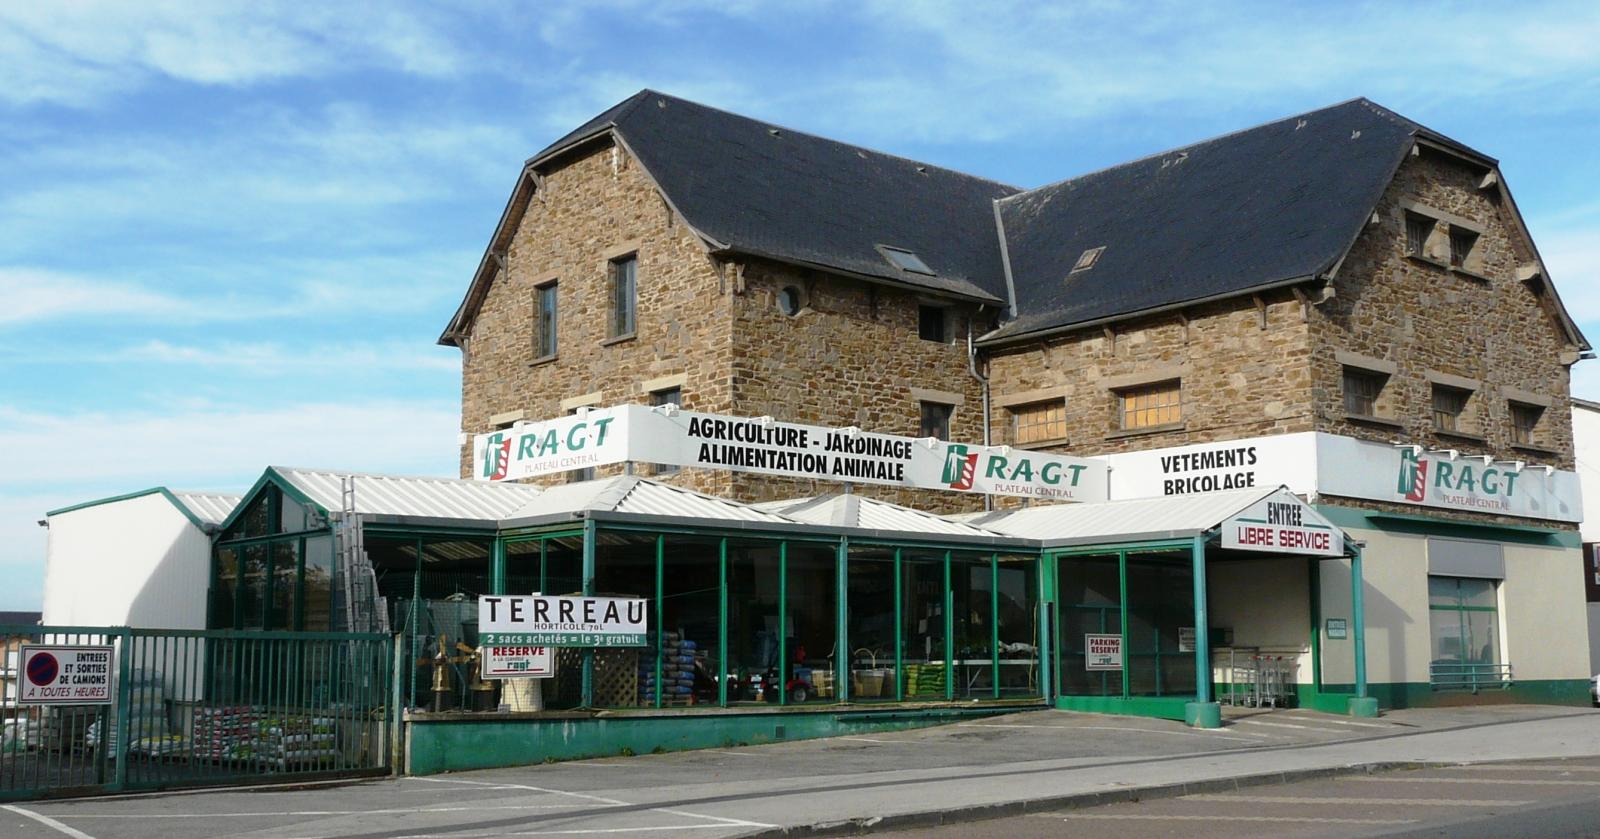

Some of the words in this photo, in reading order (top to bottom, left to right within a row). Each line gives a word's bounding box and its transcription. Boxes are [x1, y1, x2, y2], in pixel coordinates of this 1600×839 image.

[687, 416, 808, 448] AGRICULTURE
[825, 432, 913, 460] JARDINAGE
[524, 459, 559, 473] PLATEAU
[560, 452, 599, 467] CENTRAL
[698, 443, 828, 473] ALIMENTATION
[832, 456, 904, 482] ANIMALE
[1161, 446, 1257, 473] VETEMENTS
[994, 484, 1033, 496] PLATEAU
[1035, 486, 1074, 499] CENTRAL
[1163, 472, 1255, 496] BRICOLAGE
[1443, 494, 1475, 506] PLATEAU
[1476, 498, 1509, 511] CENTRAL
[1267, 501, 1302, 527] ENTREE
[1238, 527, 1274, 546] LIBRE
[1279, 530, 1330, 550] SERVICE
[485, 597, 644, 625] TERREAU
[534, 622, 586, 631] HORTICOLE
[487, 634, 494, 643] 2
[499, 635, 522, 643] sacs
[526, 633, 566, 643] achetés
[581, 634, 591, 643] le
[606, 634, 640, 646] gratuit
[1090, 638, 1120, 646] PARKING
[77, 652, 108, 662] ENTREES
[492, 646, 545, 657] RESERVE
[65, 663, 73, 673] ET
[77, 663, 107, 674] SORTIES
[60, 675, 69, 684] DE
[72, 674, 106, 684] CAMIONS
[40, 687, 71, 697] TOUTES
[74, 687, 106, 697] HEURES
